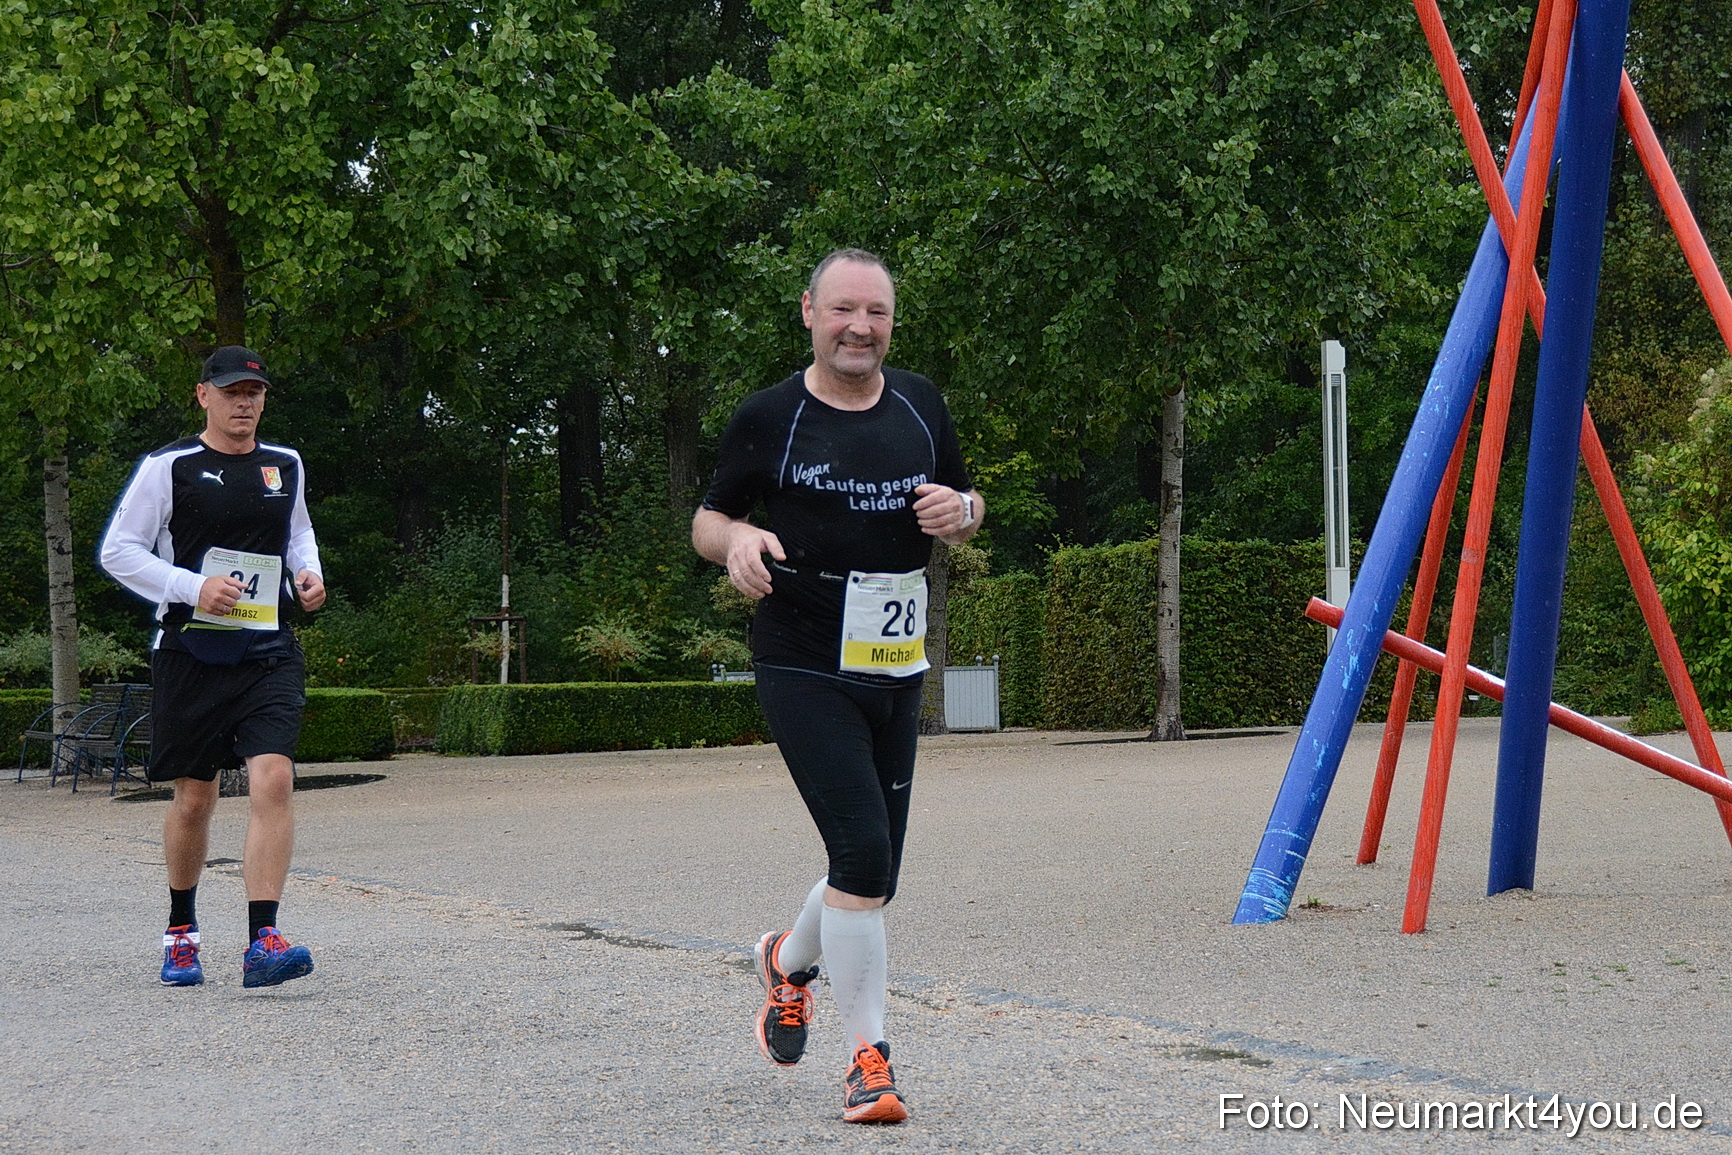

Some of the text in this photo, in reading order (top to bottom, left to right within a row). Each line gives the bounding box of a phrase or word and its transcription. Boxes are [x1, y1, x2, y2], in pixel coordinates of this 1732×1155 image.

[793, 462, 831, 486] Vegan
[814, 473, 927, 496] Laufen gegen
[849, 495, 906, 511] Leiden
[881, 598, 916, 637] 28
